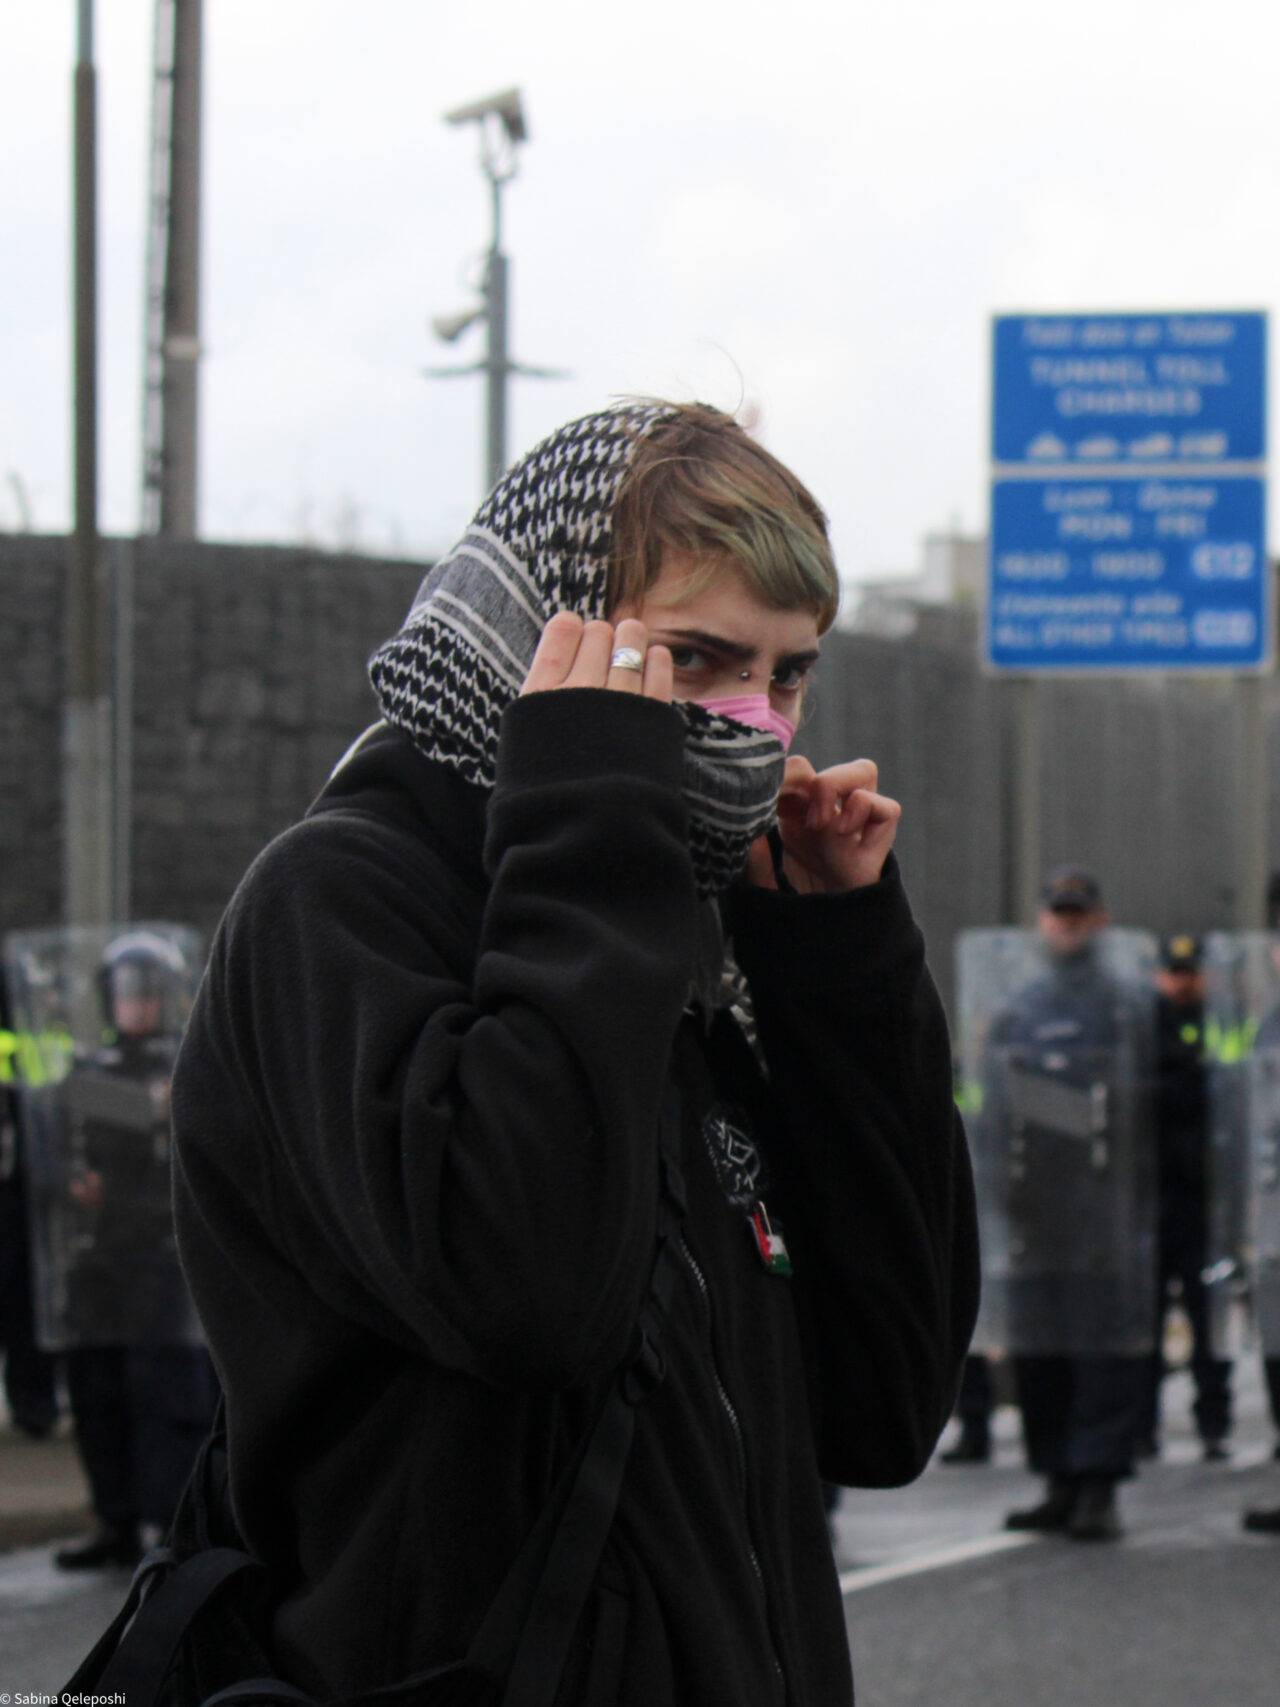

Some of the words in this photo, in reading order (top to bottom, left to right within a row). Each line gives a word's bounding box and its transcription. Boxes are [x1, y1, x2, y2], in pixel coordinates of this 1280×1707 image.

[1030, 357, 1147, 385] TUNNEL
[1157, 356, 1227, 384] TOLL
[1058, 389, 1200, 416] CHARGES
